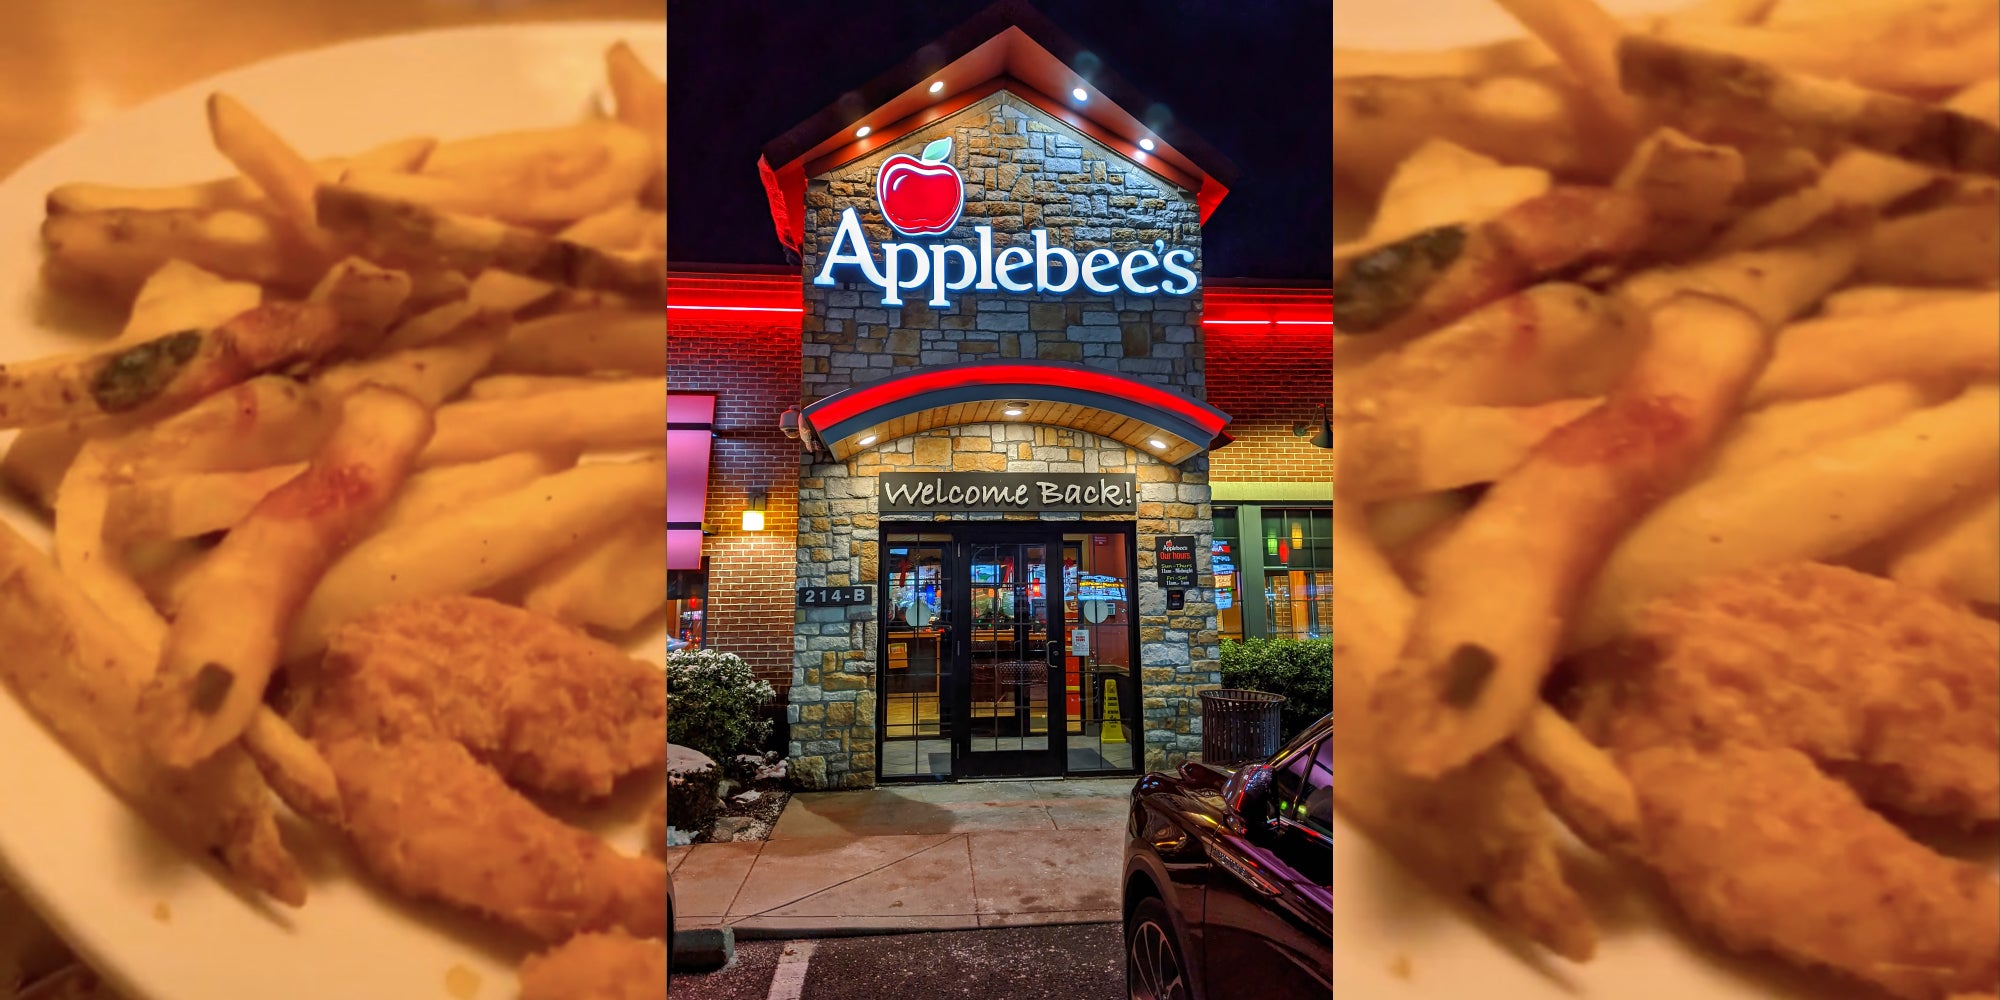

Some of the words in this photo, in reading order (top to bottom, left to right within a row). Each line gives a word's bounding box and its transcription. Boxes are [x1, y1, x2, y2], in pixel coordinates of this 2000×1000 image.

[813, 206, 1199, 308] Applebee's
[885, 477, 1029, 506] Welcome
[1036, 478, 1132, 506] Back!
[1160, 551, 1171, 560] Our
[805, 588, 865, 603] 214-B
